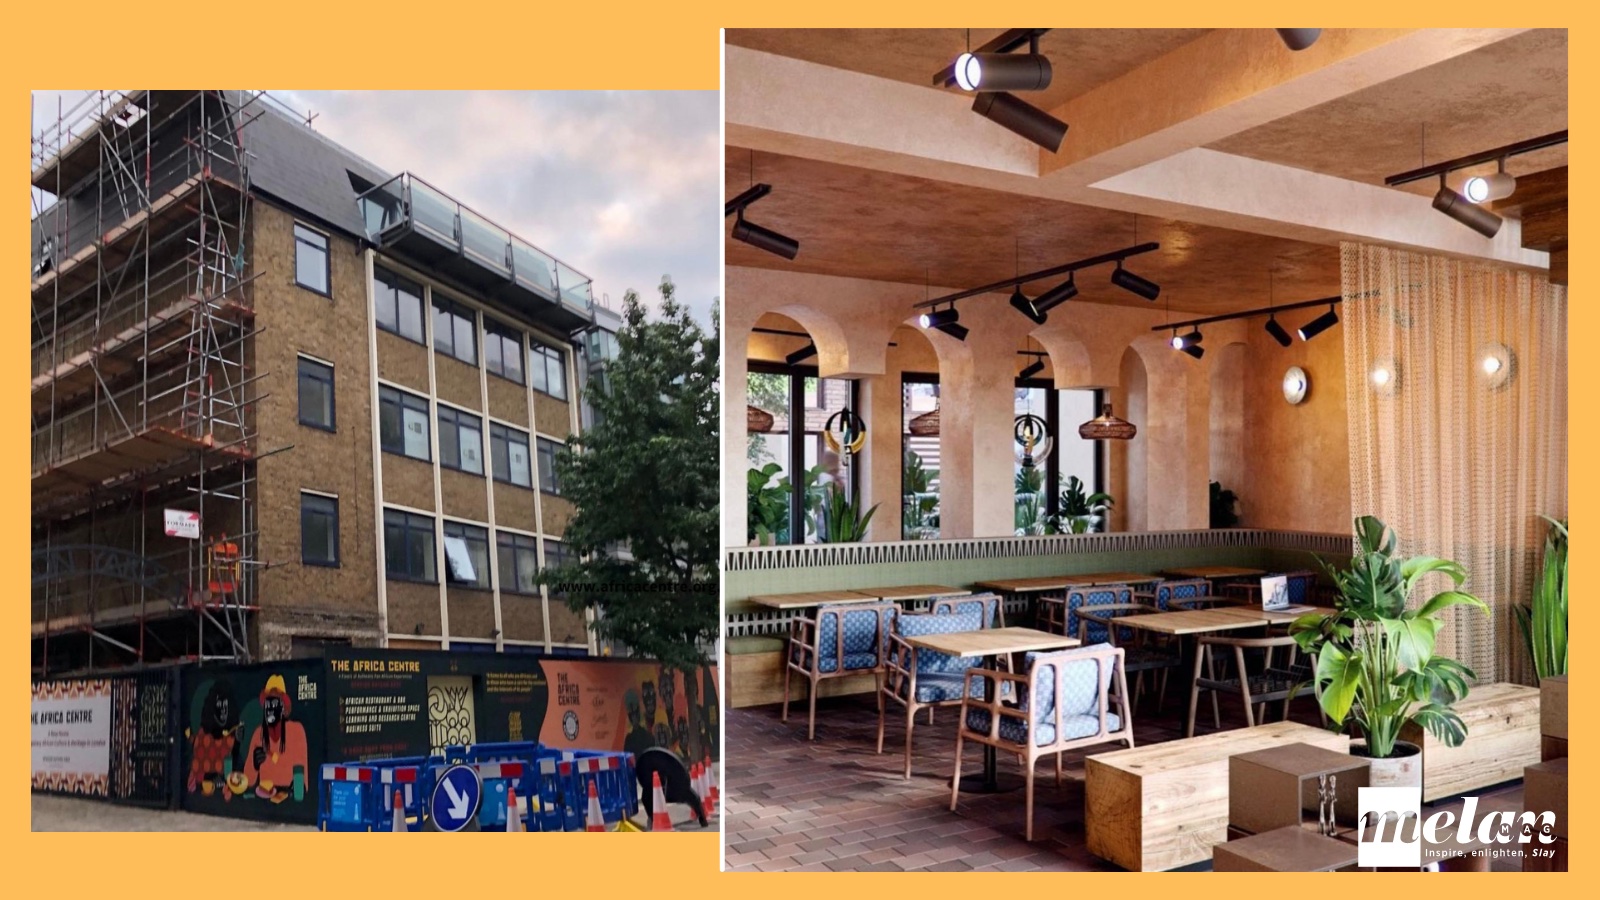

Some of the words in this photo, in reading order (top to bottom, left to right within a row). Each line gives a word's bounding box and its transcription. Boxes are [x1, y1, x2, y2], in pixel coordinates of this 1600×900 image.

[331, 660, 349, 672] THE
[353, 660, 385, 672] AFRICA
[388, 660, 420, 673] CENTRE
[298, 675, 308, 684] THE
[557, 672, 568, 683] THE
[298, 682, 317, 692] AFRICA
[558, 683, 579, 695] AFRICA
[298, 691, 317, 701] CENTRE
[558, 695, 580, 706] CENTRE
[41, 711, 63, 725] AFRICA
[66, 709, 93, 724] CENTRE
